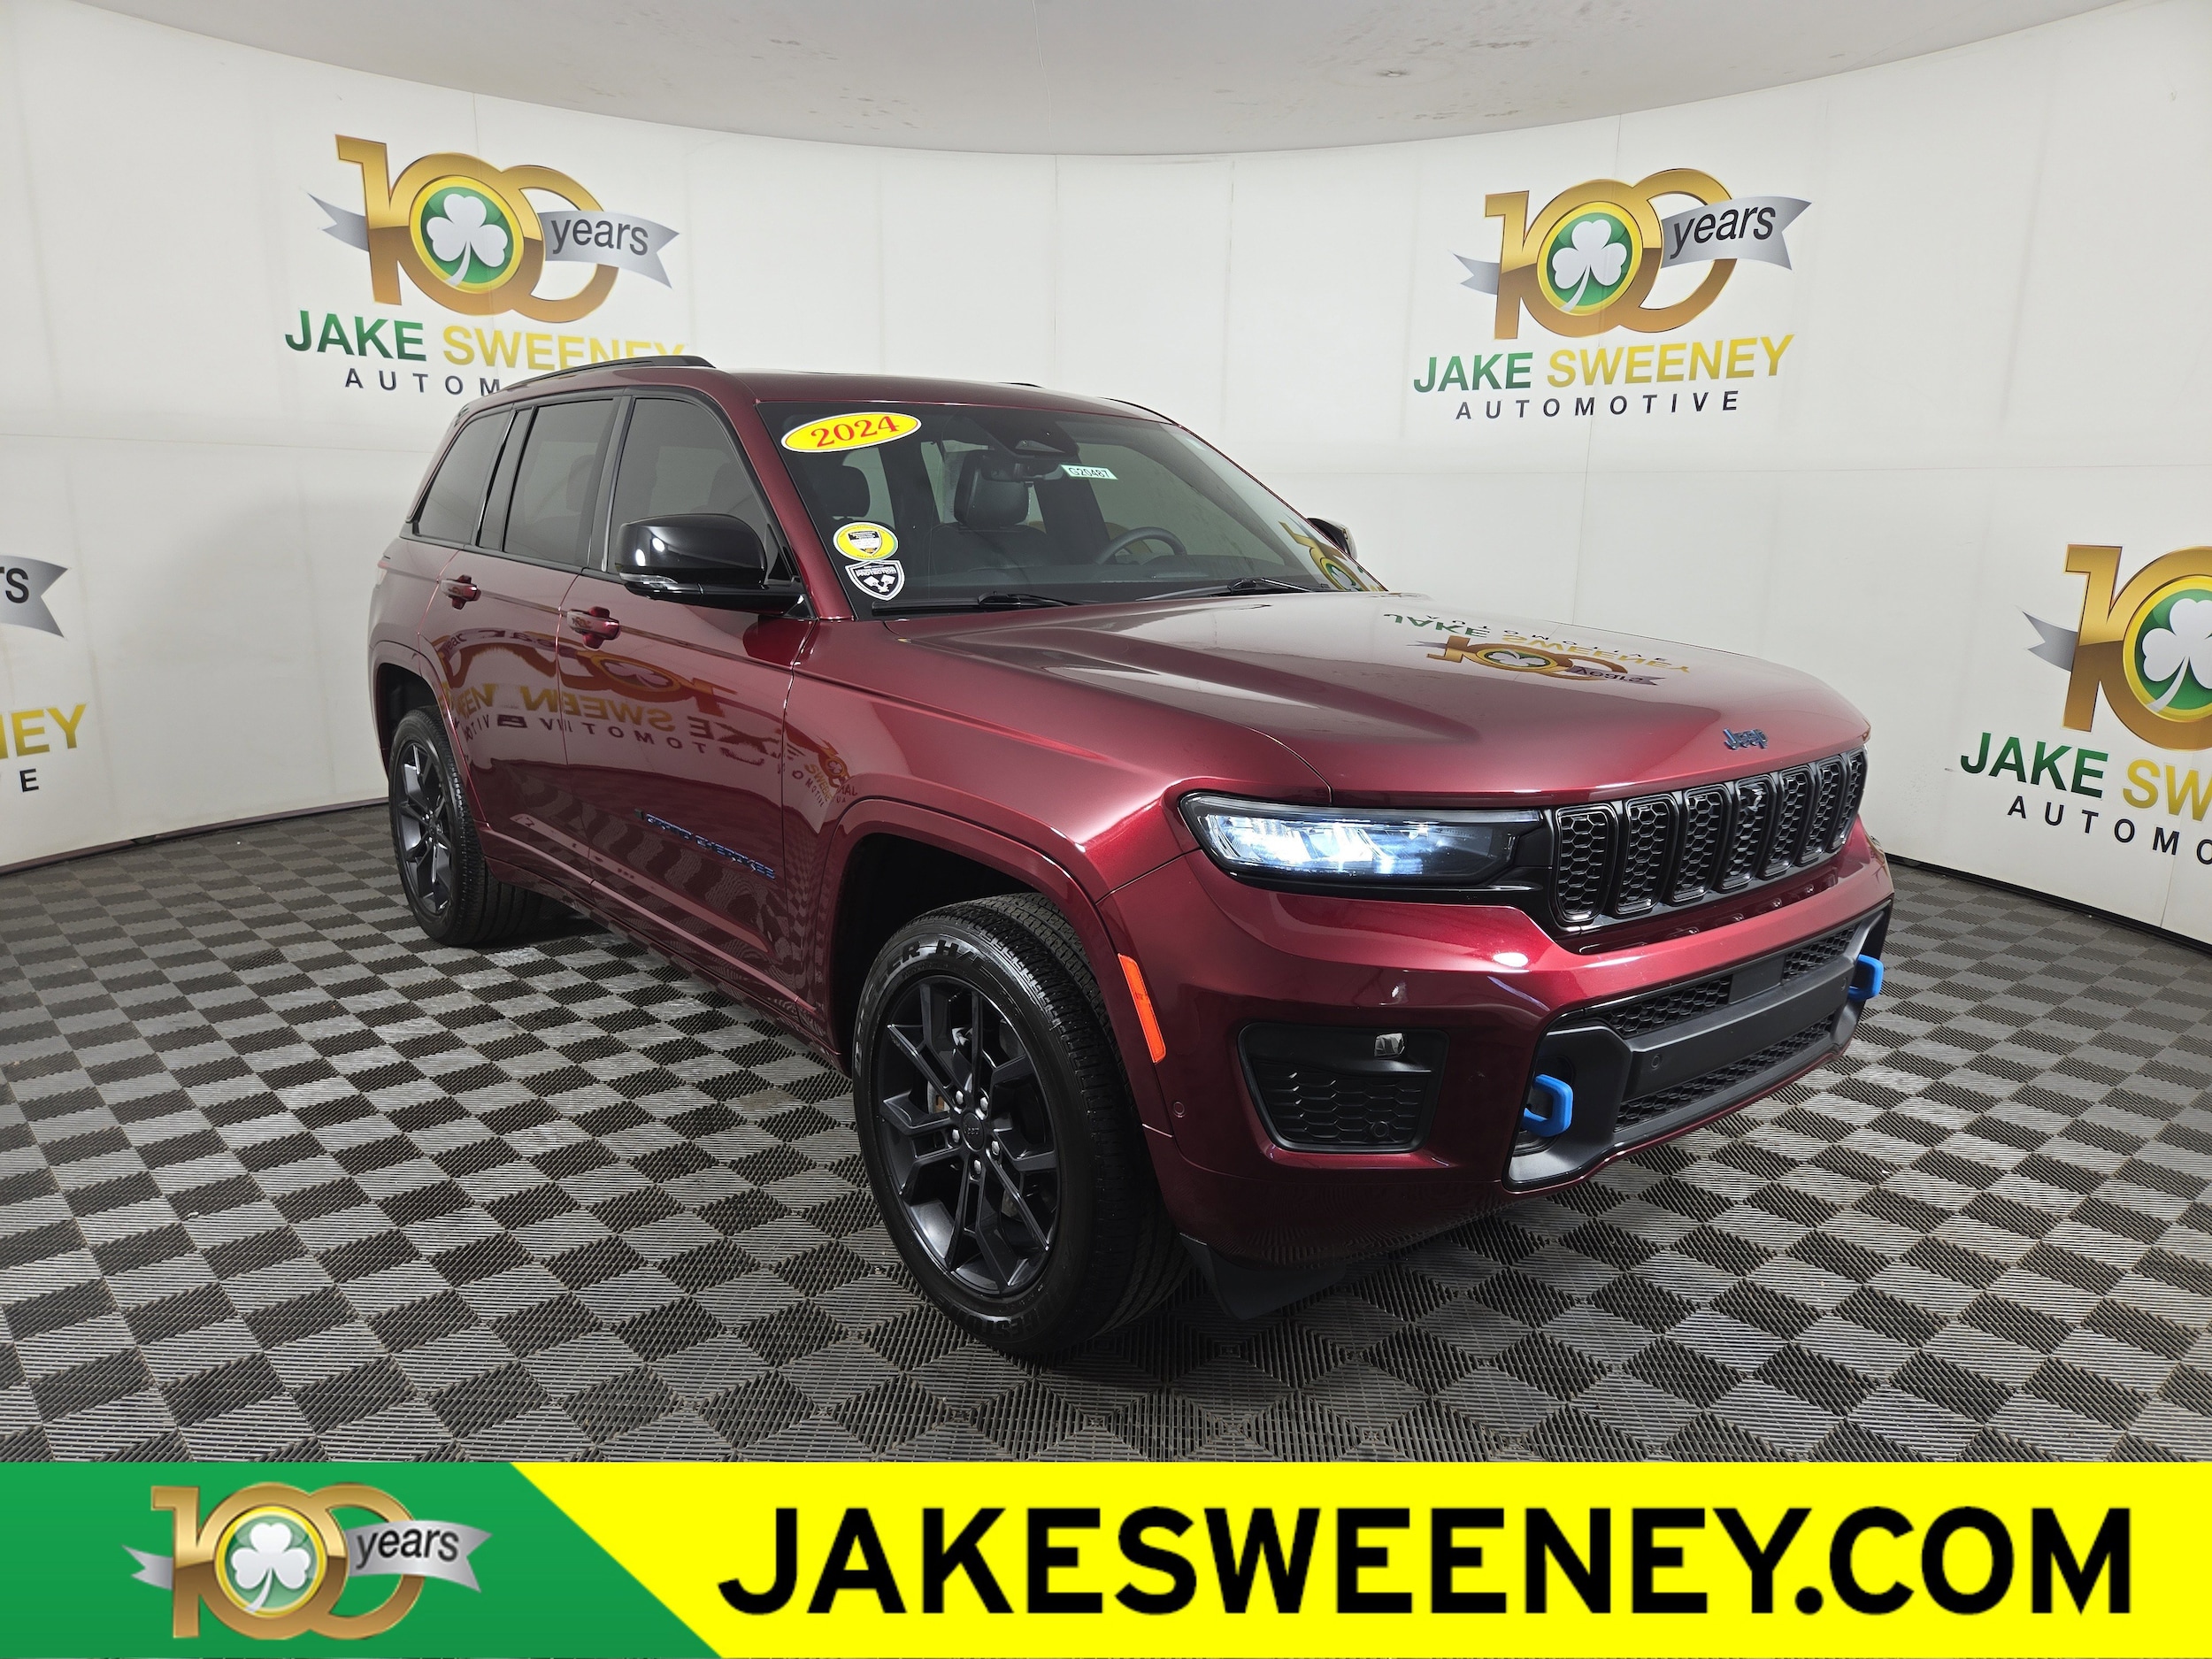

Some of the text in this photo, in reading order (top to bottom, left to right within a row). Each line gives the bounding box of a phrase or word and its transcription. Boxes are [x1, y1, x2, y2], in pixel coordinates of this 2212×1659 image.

[550, 219, 649, 256] years
[1669, 206, 1777, 260] years
[285, 310, 426, 362] JAKE
[1413, 334, 1794, 393] JAKE SWEENEY
[1455, 390, 1739, 420] AUTOMOTIVE
[810, 416, 900, 448] 2024
[1723, 728, 1768, 749] Jeep
[1960, 732, 2109, 799] JAKE
